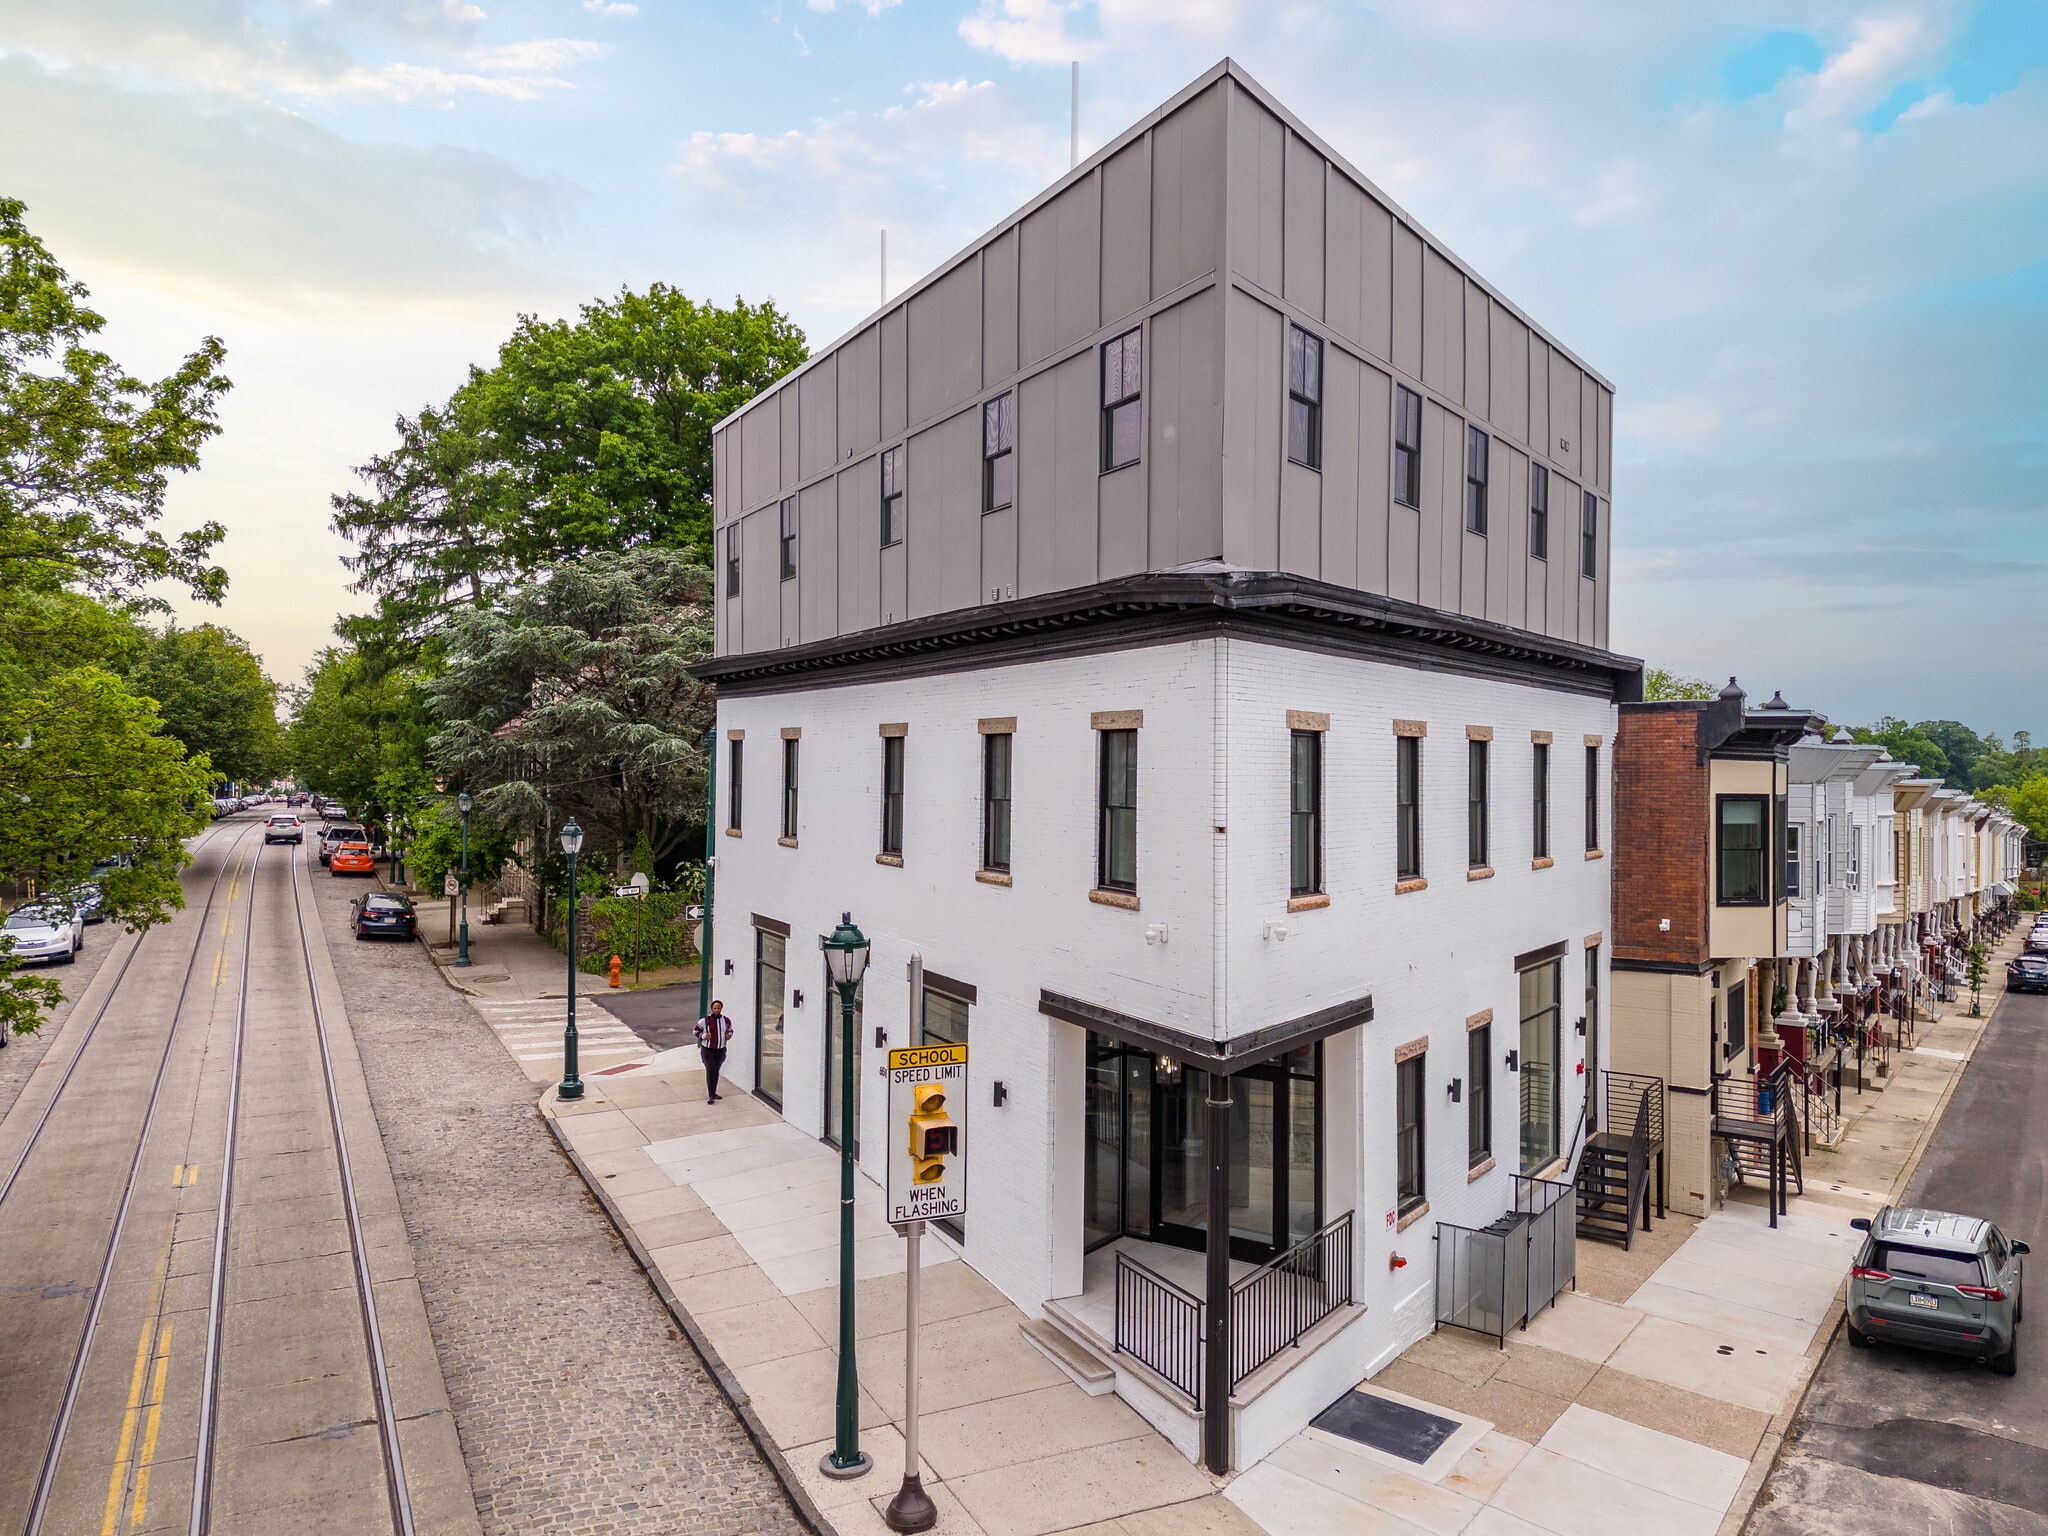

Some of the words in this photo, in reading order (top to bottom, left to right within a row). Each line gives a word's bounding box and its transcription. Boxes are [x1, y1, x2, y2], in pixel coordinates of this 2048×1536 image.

[899, 1049, 958, 1066] SCHOOL
[894, 1068, 930, 1084] SPEED
[935, 1065, 962, 1080] LIMIT
[909, 1186, 946, 1203] WHEN
[895, 1199, 959, 1219] FLASHING
